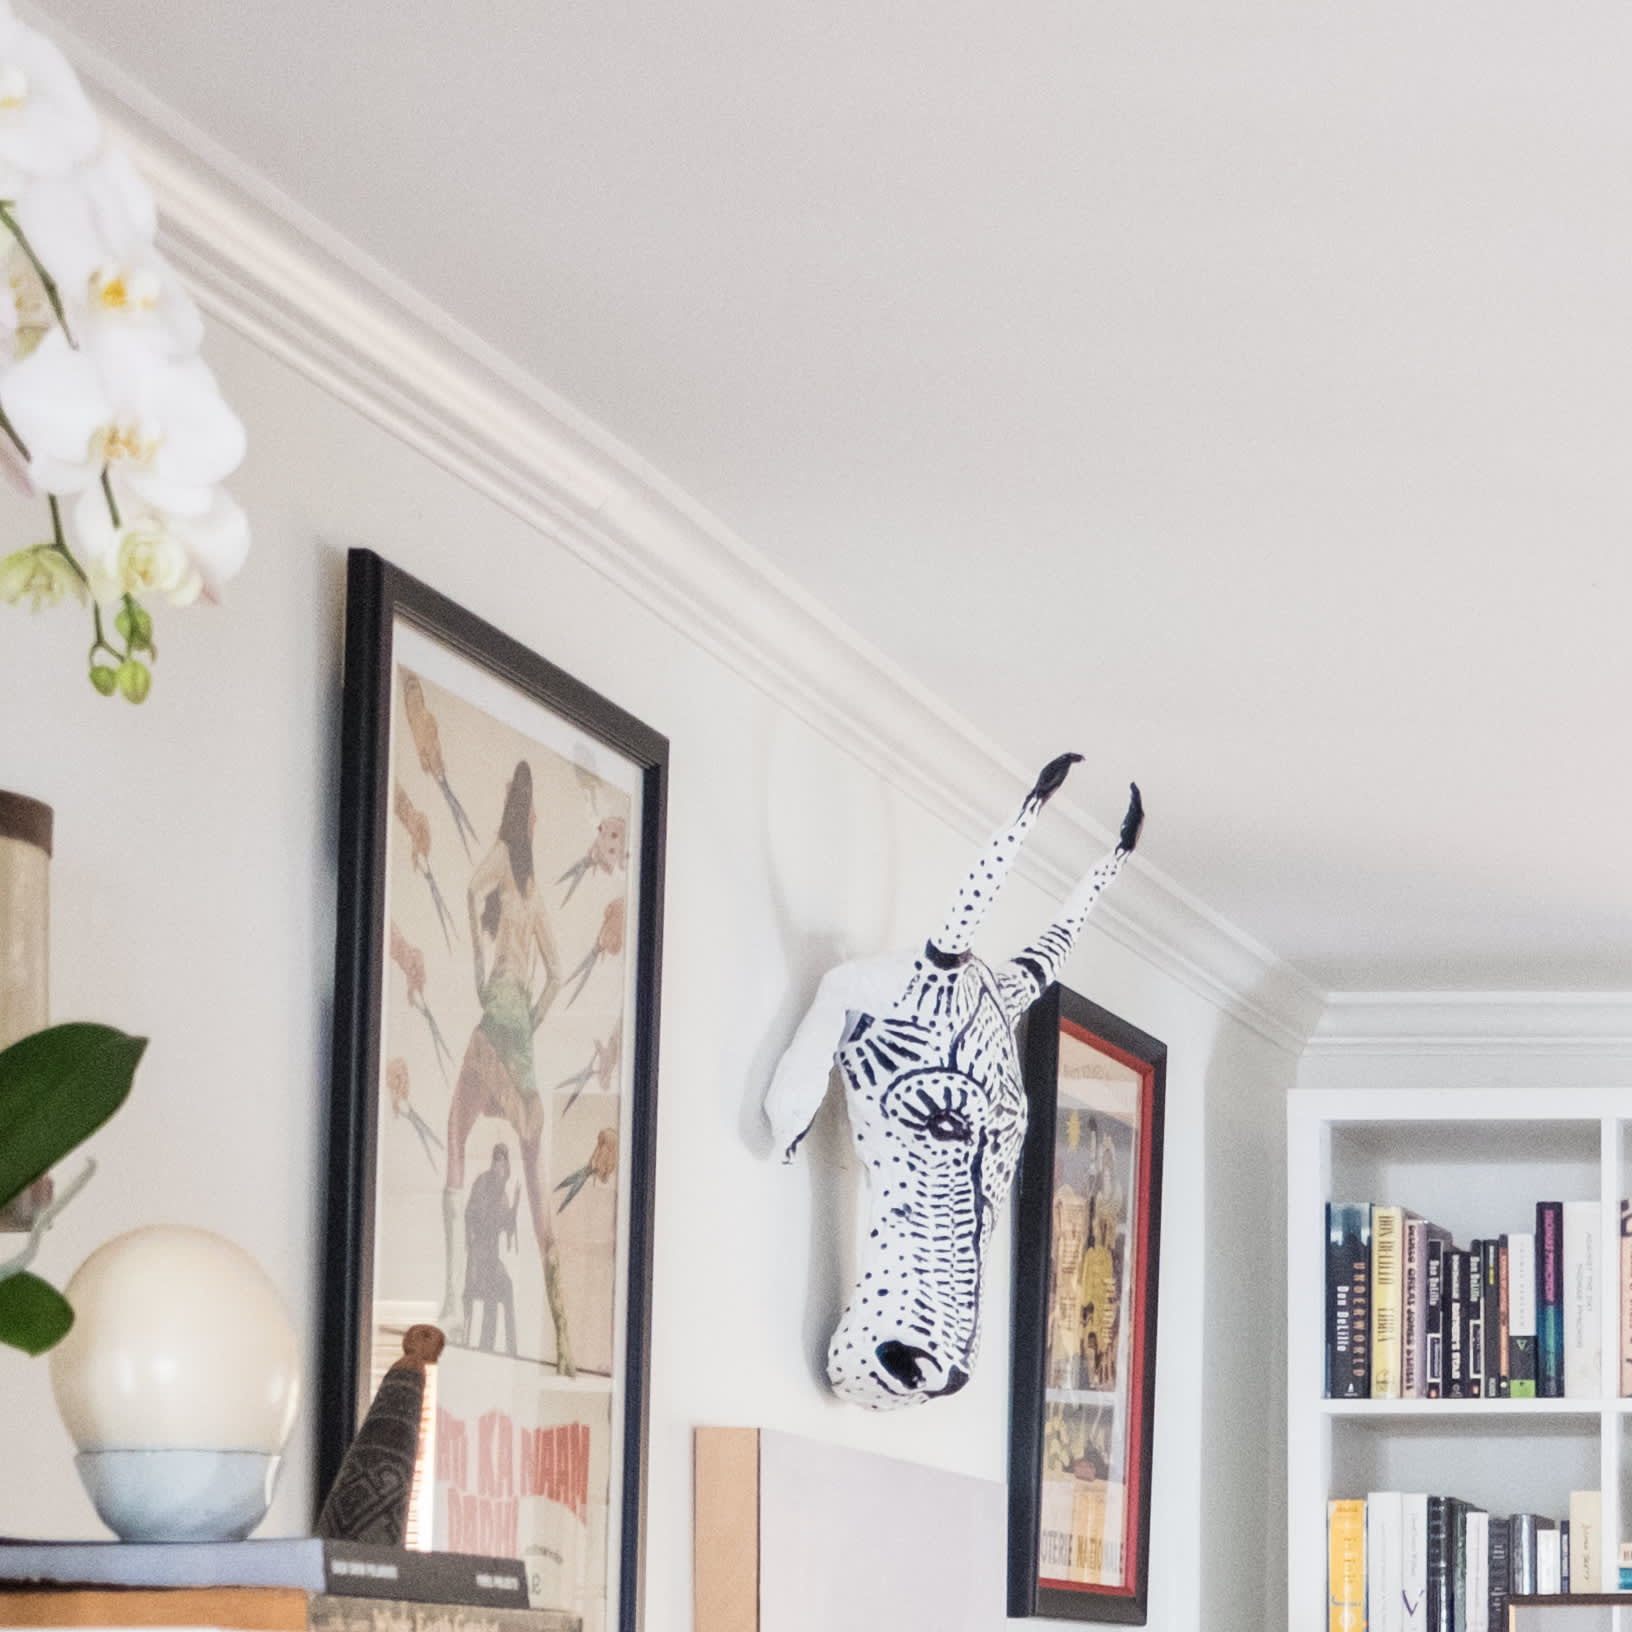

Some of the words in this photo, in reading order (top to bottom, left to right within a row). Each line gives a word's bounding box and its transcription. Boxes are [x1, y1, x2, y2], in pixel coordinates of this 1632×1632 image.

[1337, 1285, 1350, 1306] Don
[1337, 1311, 1350, 1352] DeLillo
[1353, 1261, 1366, 1377] UNDERWORLD
